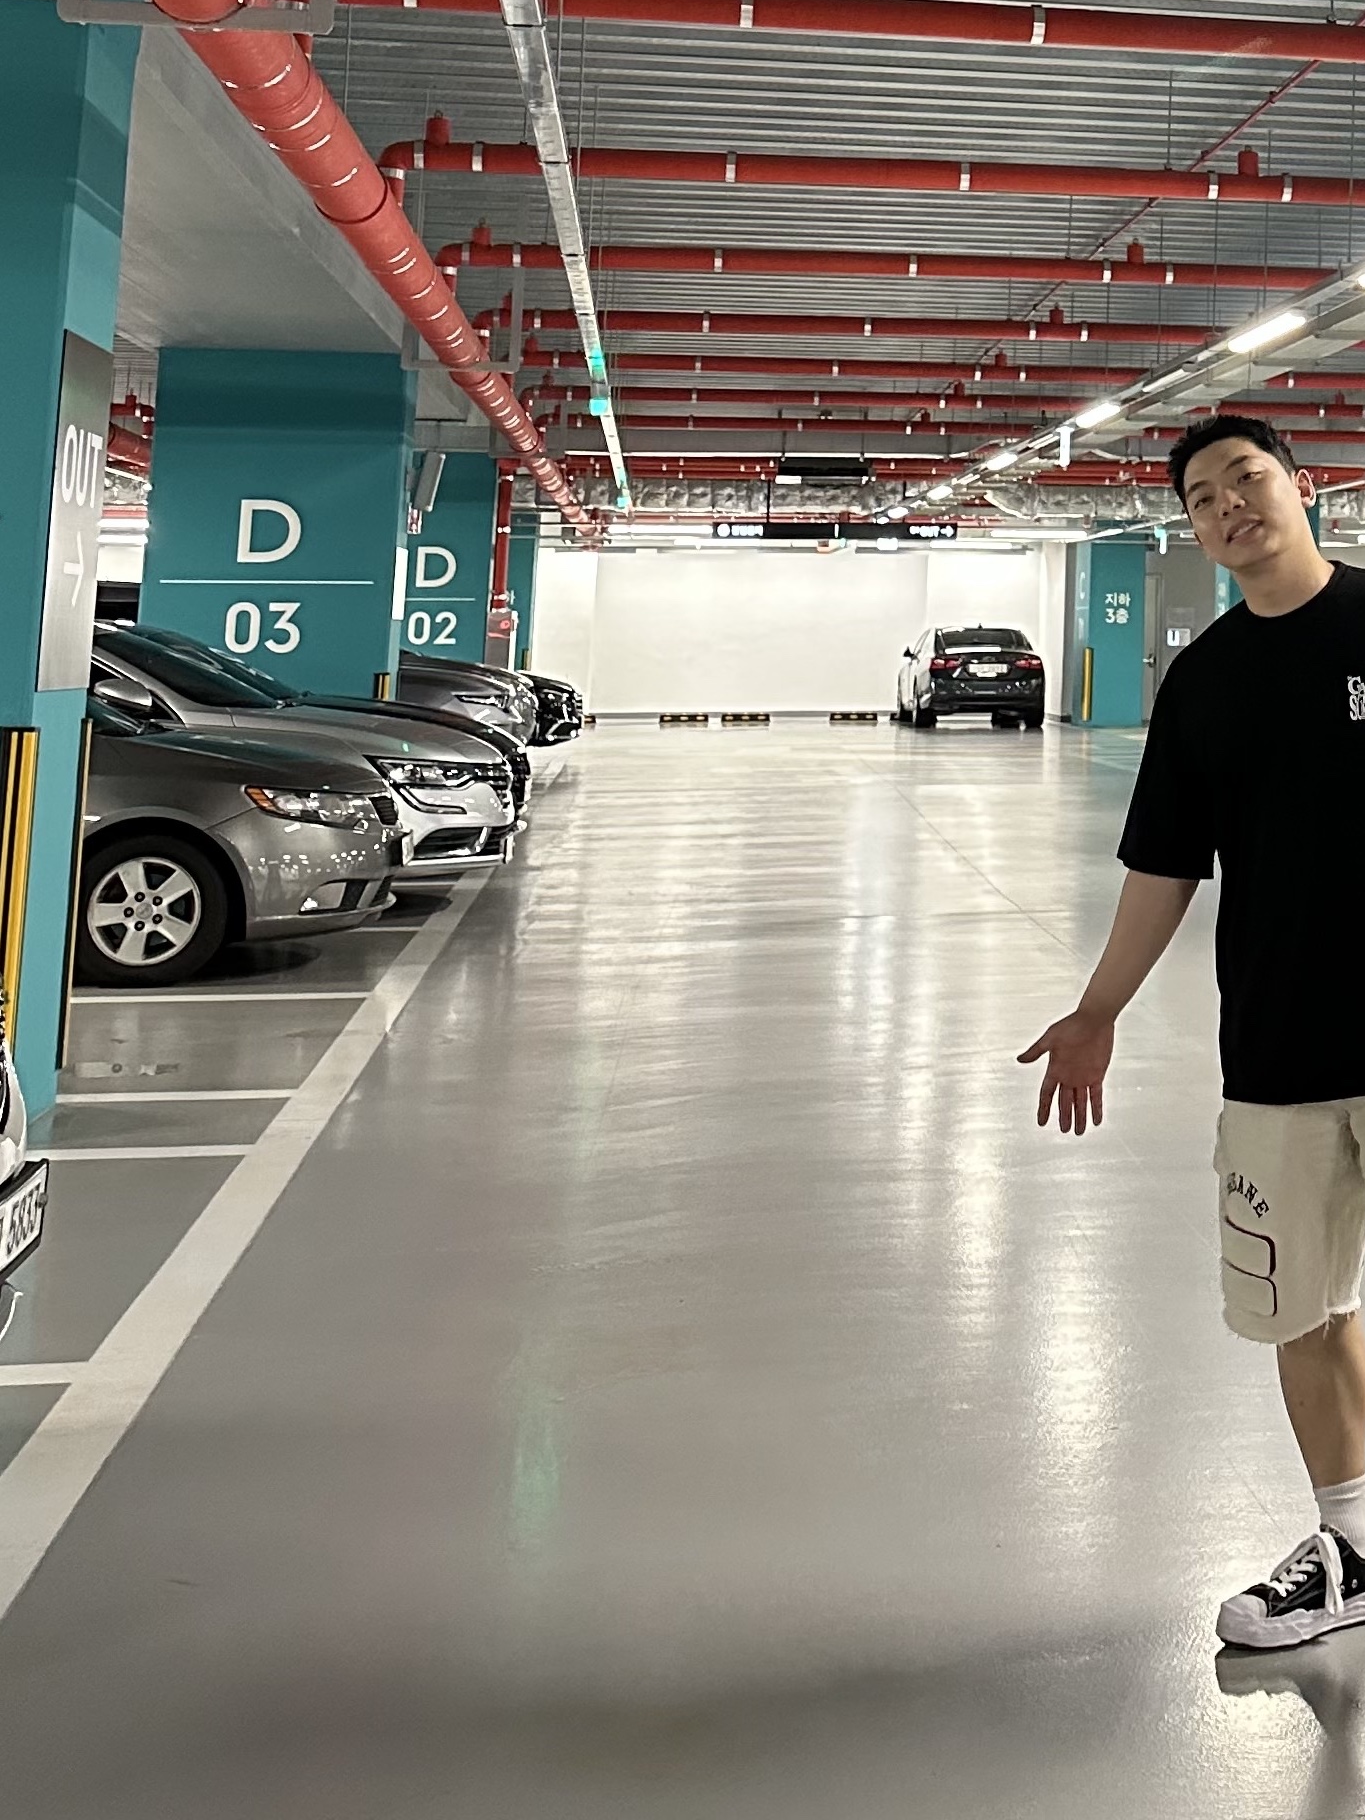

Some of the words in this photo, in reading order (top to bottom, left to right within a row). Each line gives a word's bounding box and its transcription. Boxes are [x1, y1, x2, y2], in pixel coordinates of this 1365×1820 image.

[61, 424, 103, 509] OUT
[236, 499, 302, 563] D
[415, 546, 457, 588] D
[1104, 591, 1132, 608] 지하
[1104, 608, 1130, 624] 3층
[224, 601, 302, 654] 03
[407, 611, 457, 645] 02
